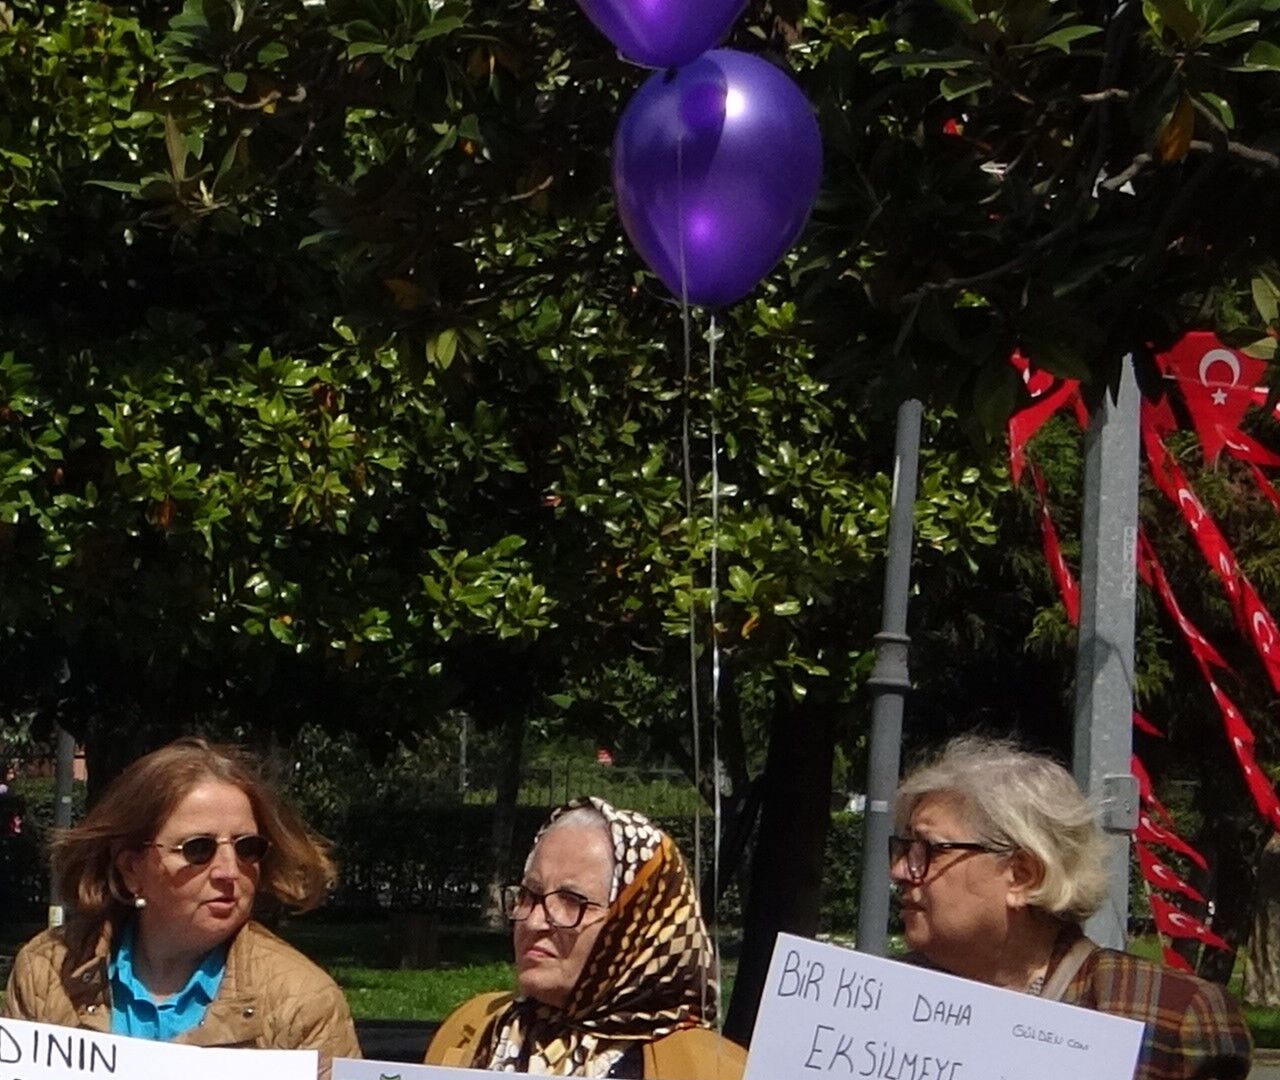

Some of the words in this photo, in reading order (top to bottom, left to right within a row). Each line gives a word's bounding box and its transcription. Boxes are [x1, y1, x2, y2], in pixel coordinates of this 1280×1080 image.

[778, 950, 825, 1002] BİR
[833, 968, 884, 1011] KİŞİ
[912, 993, 972, 1026] DAHA
